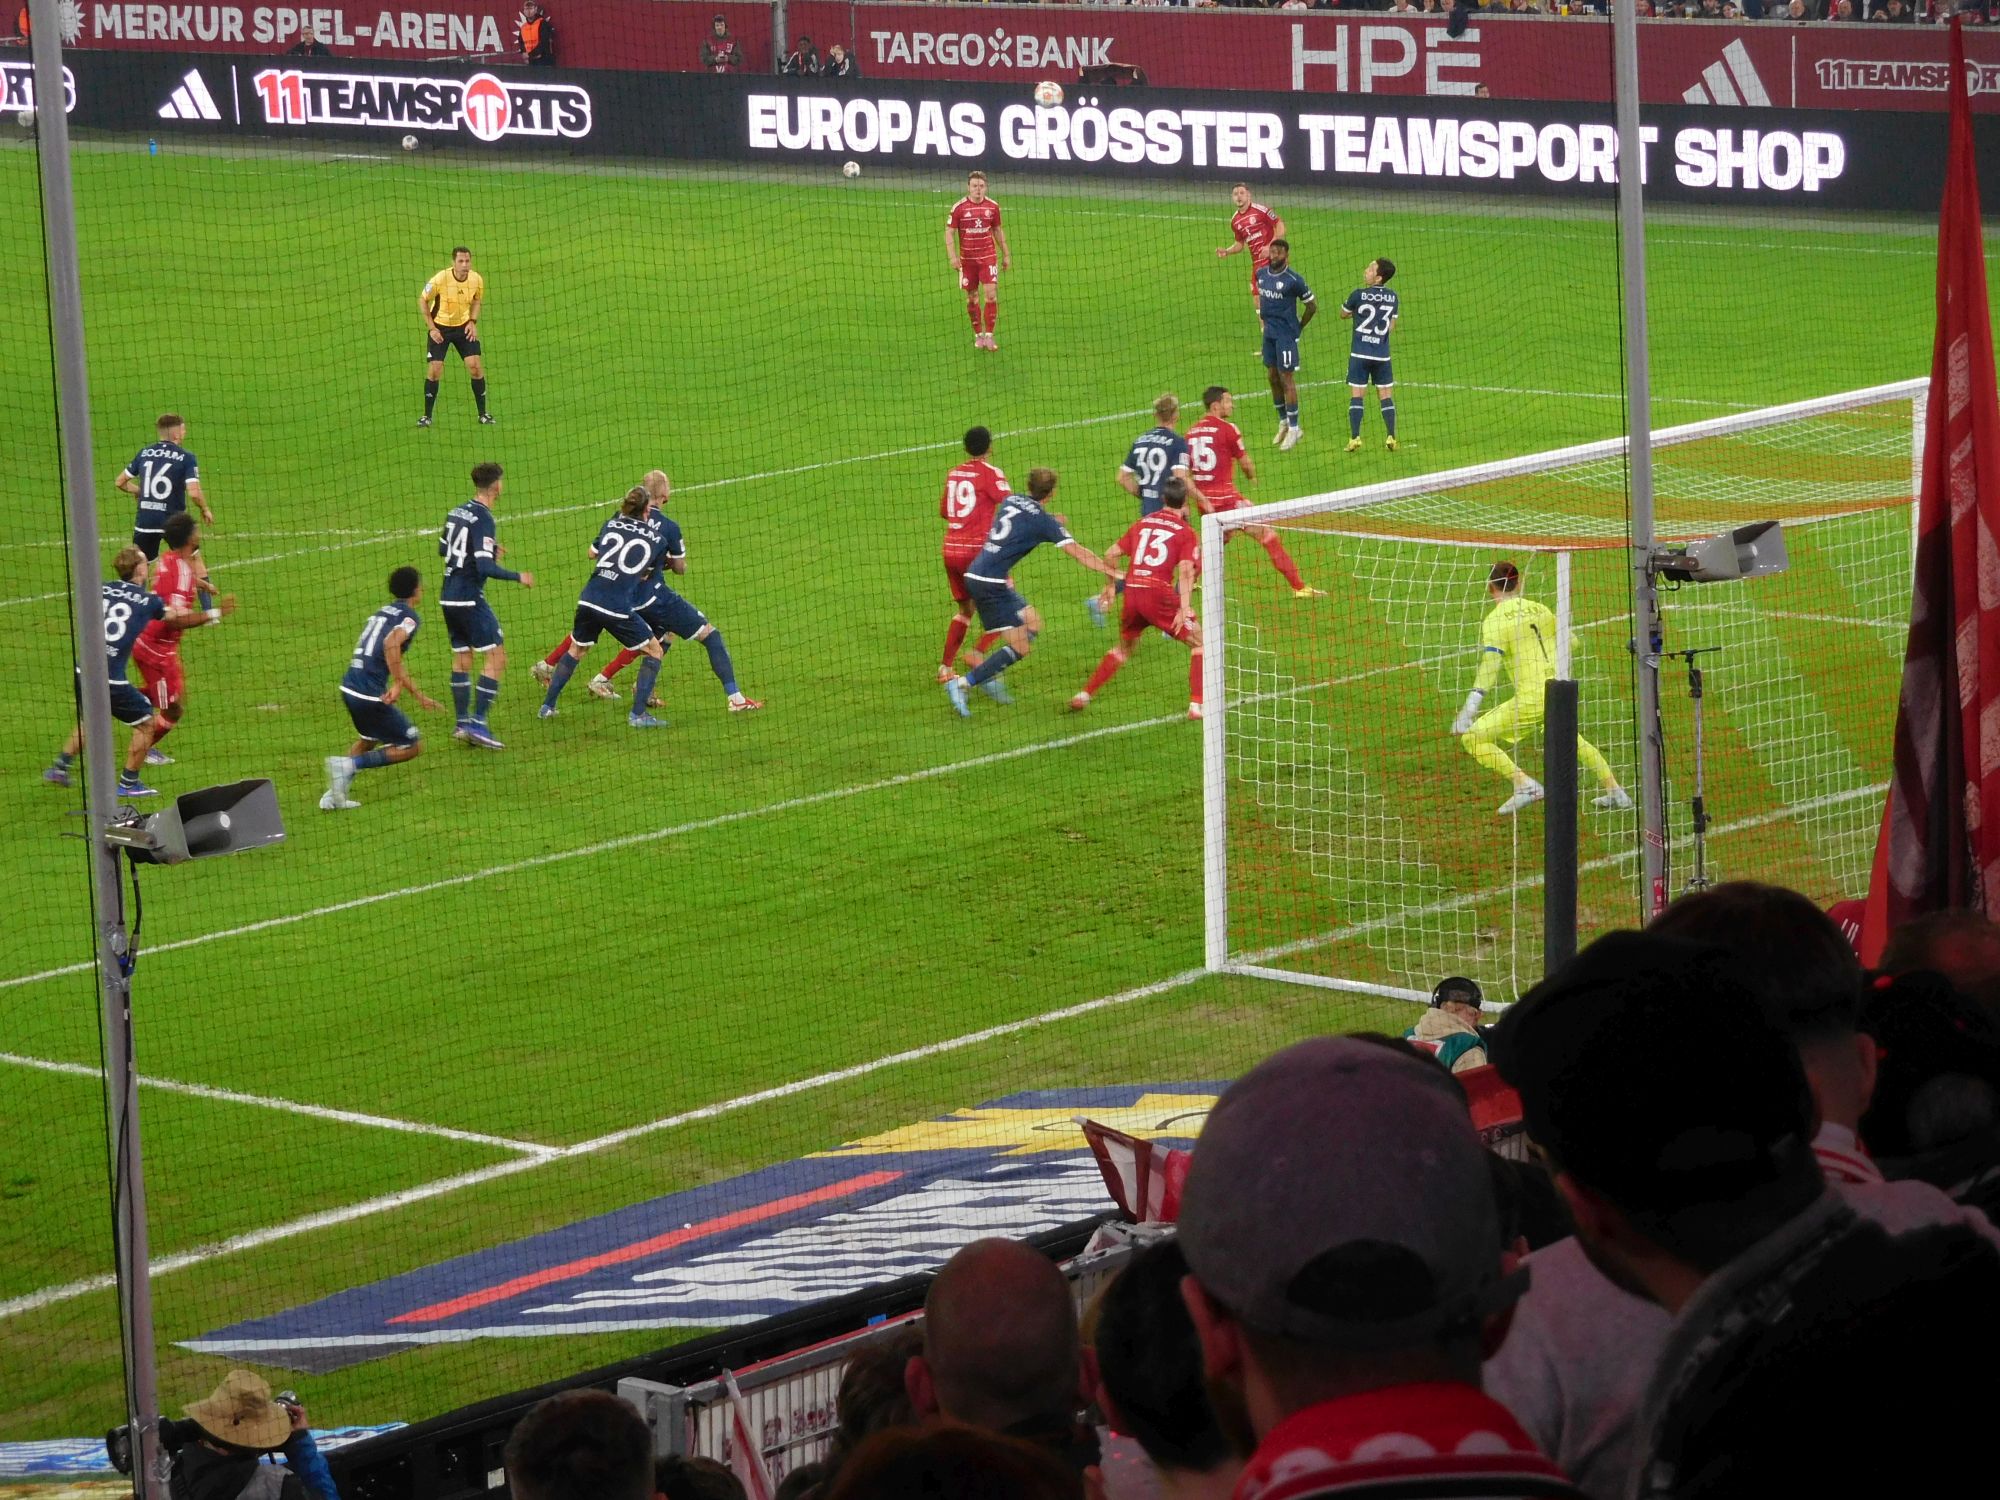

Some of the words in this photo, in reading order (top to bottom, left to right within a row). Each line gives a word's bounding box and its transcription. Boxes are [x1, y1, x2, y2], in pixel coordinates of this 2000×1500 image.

[94, 4, 245, 42] MERKUR
[252, 7, 504, 53] SPIEL-ARENA
[1291, 24, 1481, 96] HPE
[747, 95, 986, 157] EUROPAS
[1000, 96, 1284, 170] GRÖSSTER
[1299, 114, 1658, 185] TEAMSPORT
[1674, 128, 1845, 192] SHOP
[1361, 292, 1396, 303] BOCHUM
[1355, 303, 1394, 336] 23
[141, 448, 185, 462] BOCHUM
[1133, 447, 1168, 486] 39
[143, 460, 173, 500] 16
[946, 480, 977, 518] 19
[607, 520, 661, 544] BOCHUM
[1133, 527, 1176, 567] 13
[596, 531, 651, 575] 20
[102, 586, 150, 606] OCHUM
[1530, 623, 1550, 663] 1
